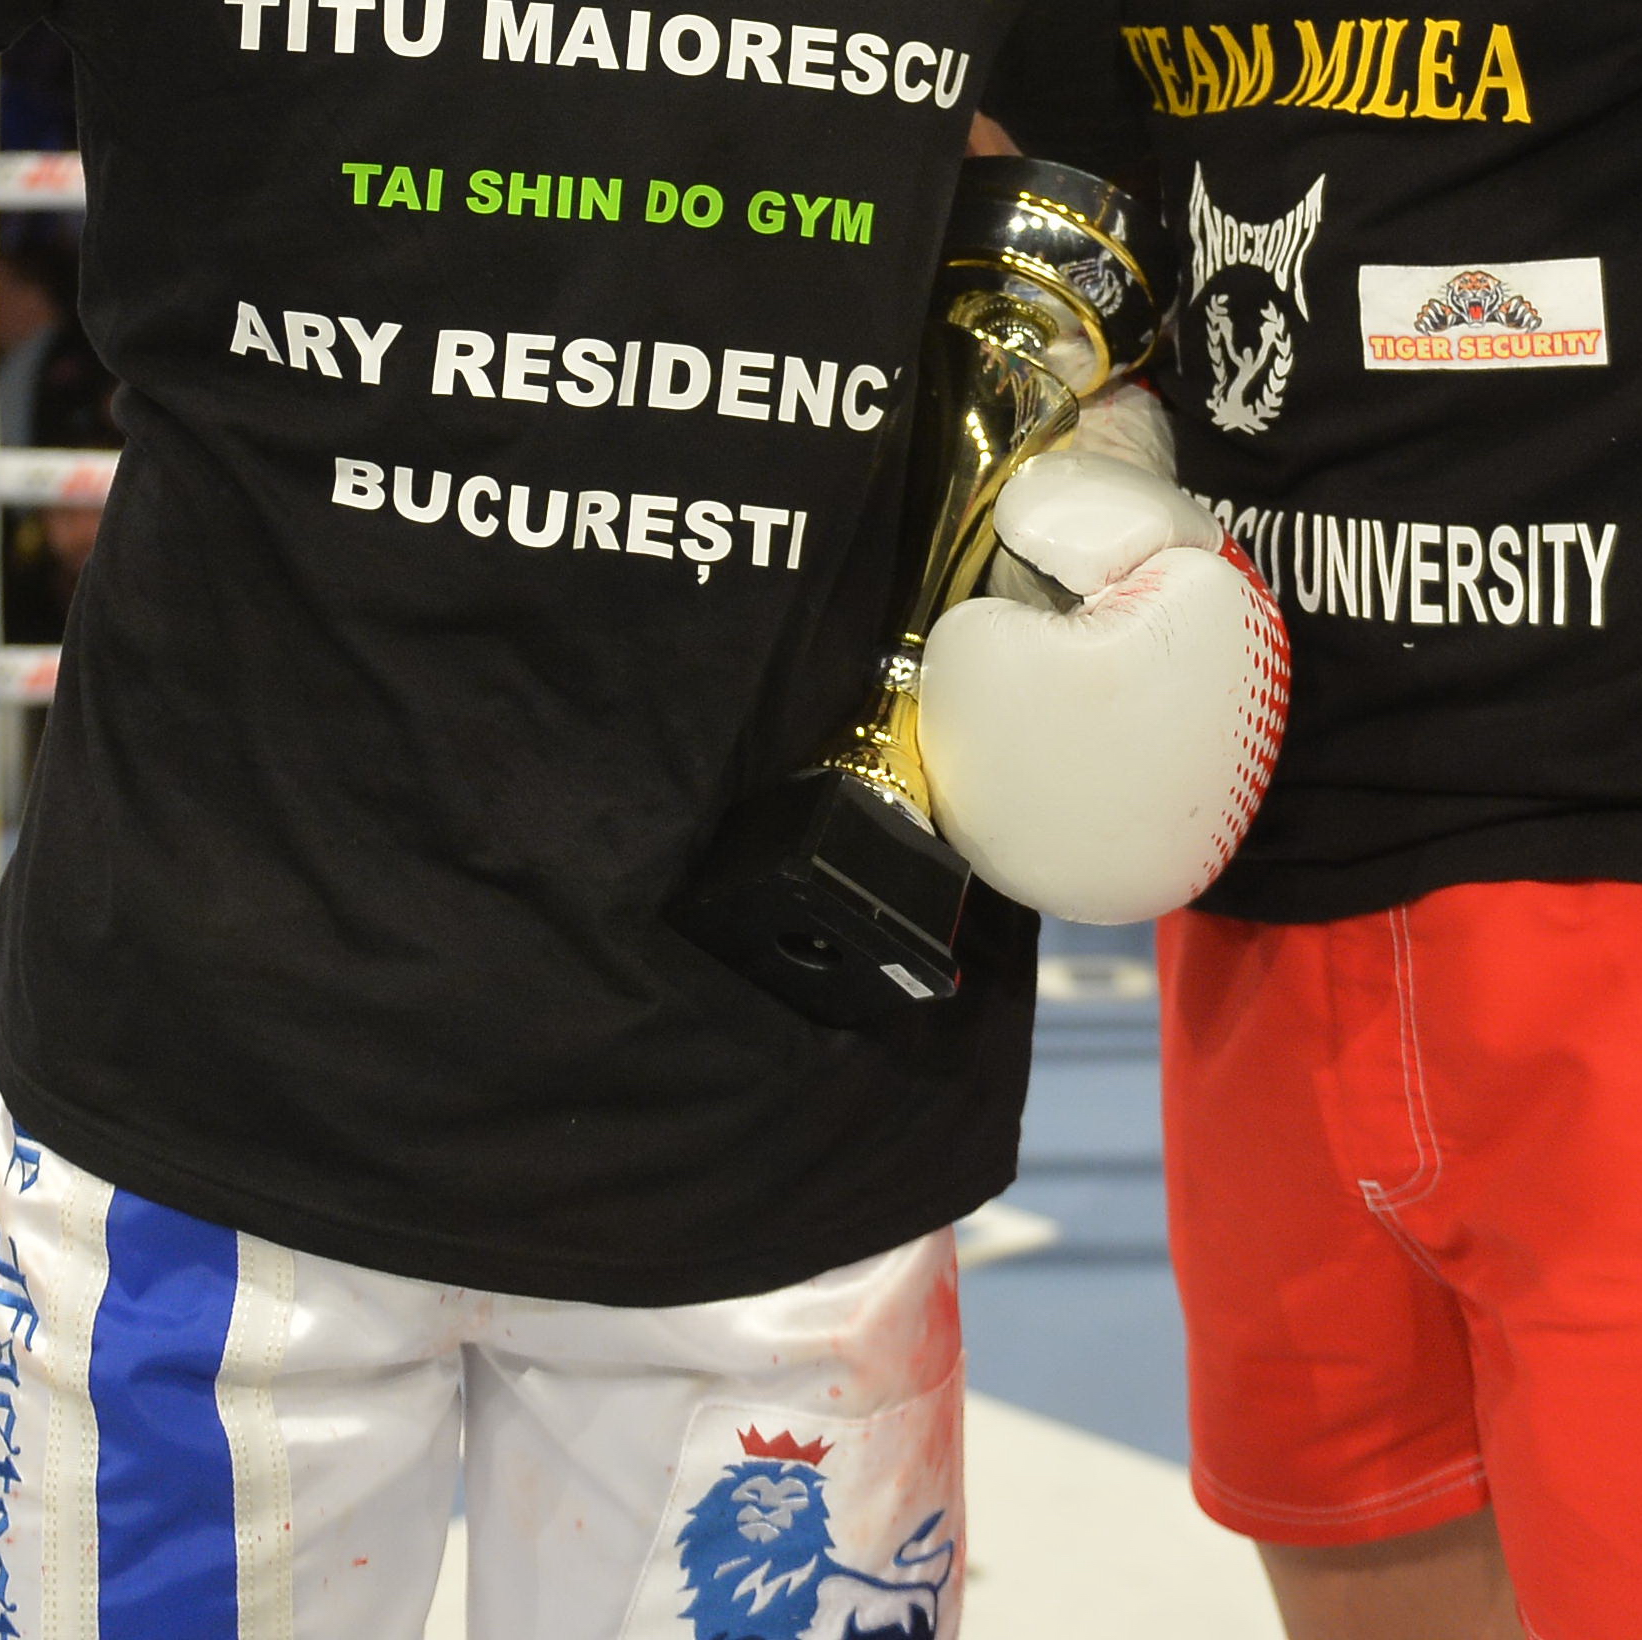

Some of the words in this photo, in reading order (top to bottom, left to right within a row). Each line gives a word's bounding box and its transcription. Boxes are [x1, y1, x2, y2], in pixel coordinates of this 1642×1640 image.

[1120, 23, 1272, 118] TEAM
[1274, 17, 1532, 125] MILEA
[341, 162, 444, 212] TAI
[465, 169, 623, 222] SHIN
[644, 179, 724, 229] DO
[747, 190, 875, 245] GYM
[1188, 160, 1326, 323] KNOCKOUT
[229, 300, 403, 385] ARY
[431, 329, 902, 432] RESIDENC
[1368, 335, 1454, 361] TIGER
[1458, 330, 1602, 360] SECURITY
[331, 456, 808, 585] BUCUREȘTI
[1294, 510, 1618, 628] UNIVERSITY
